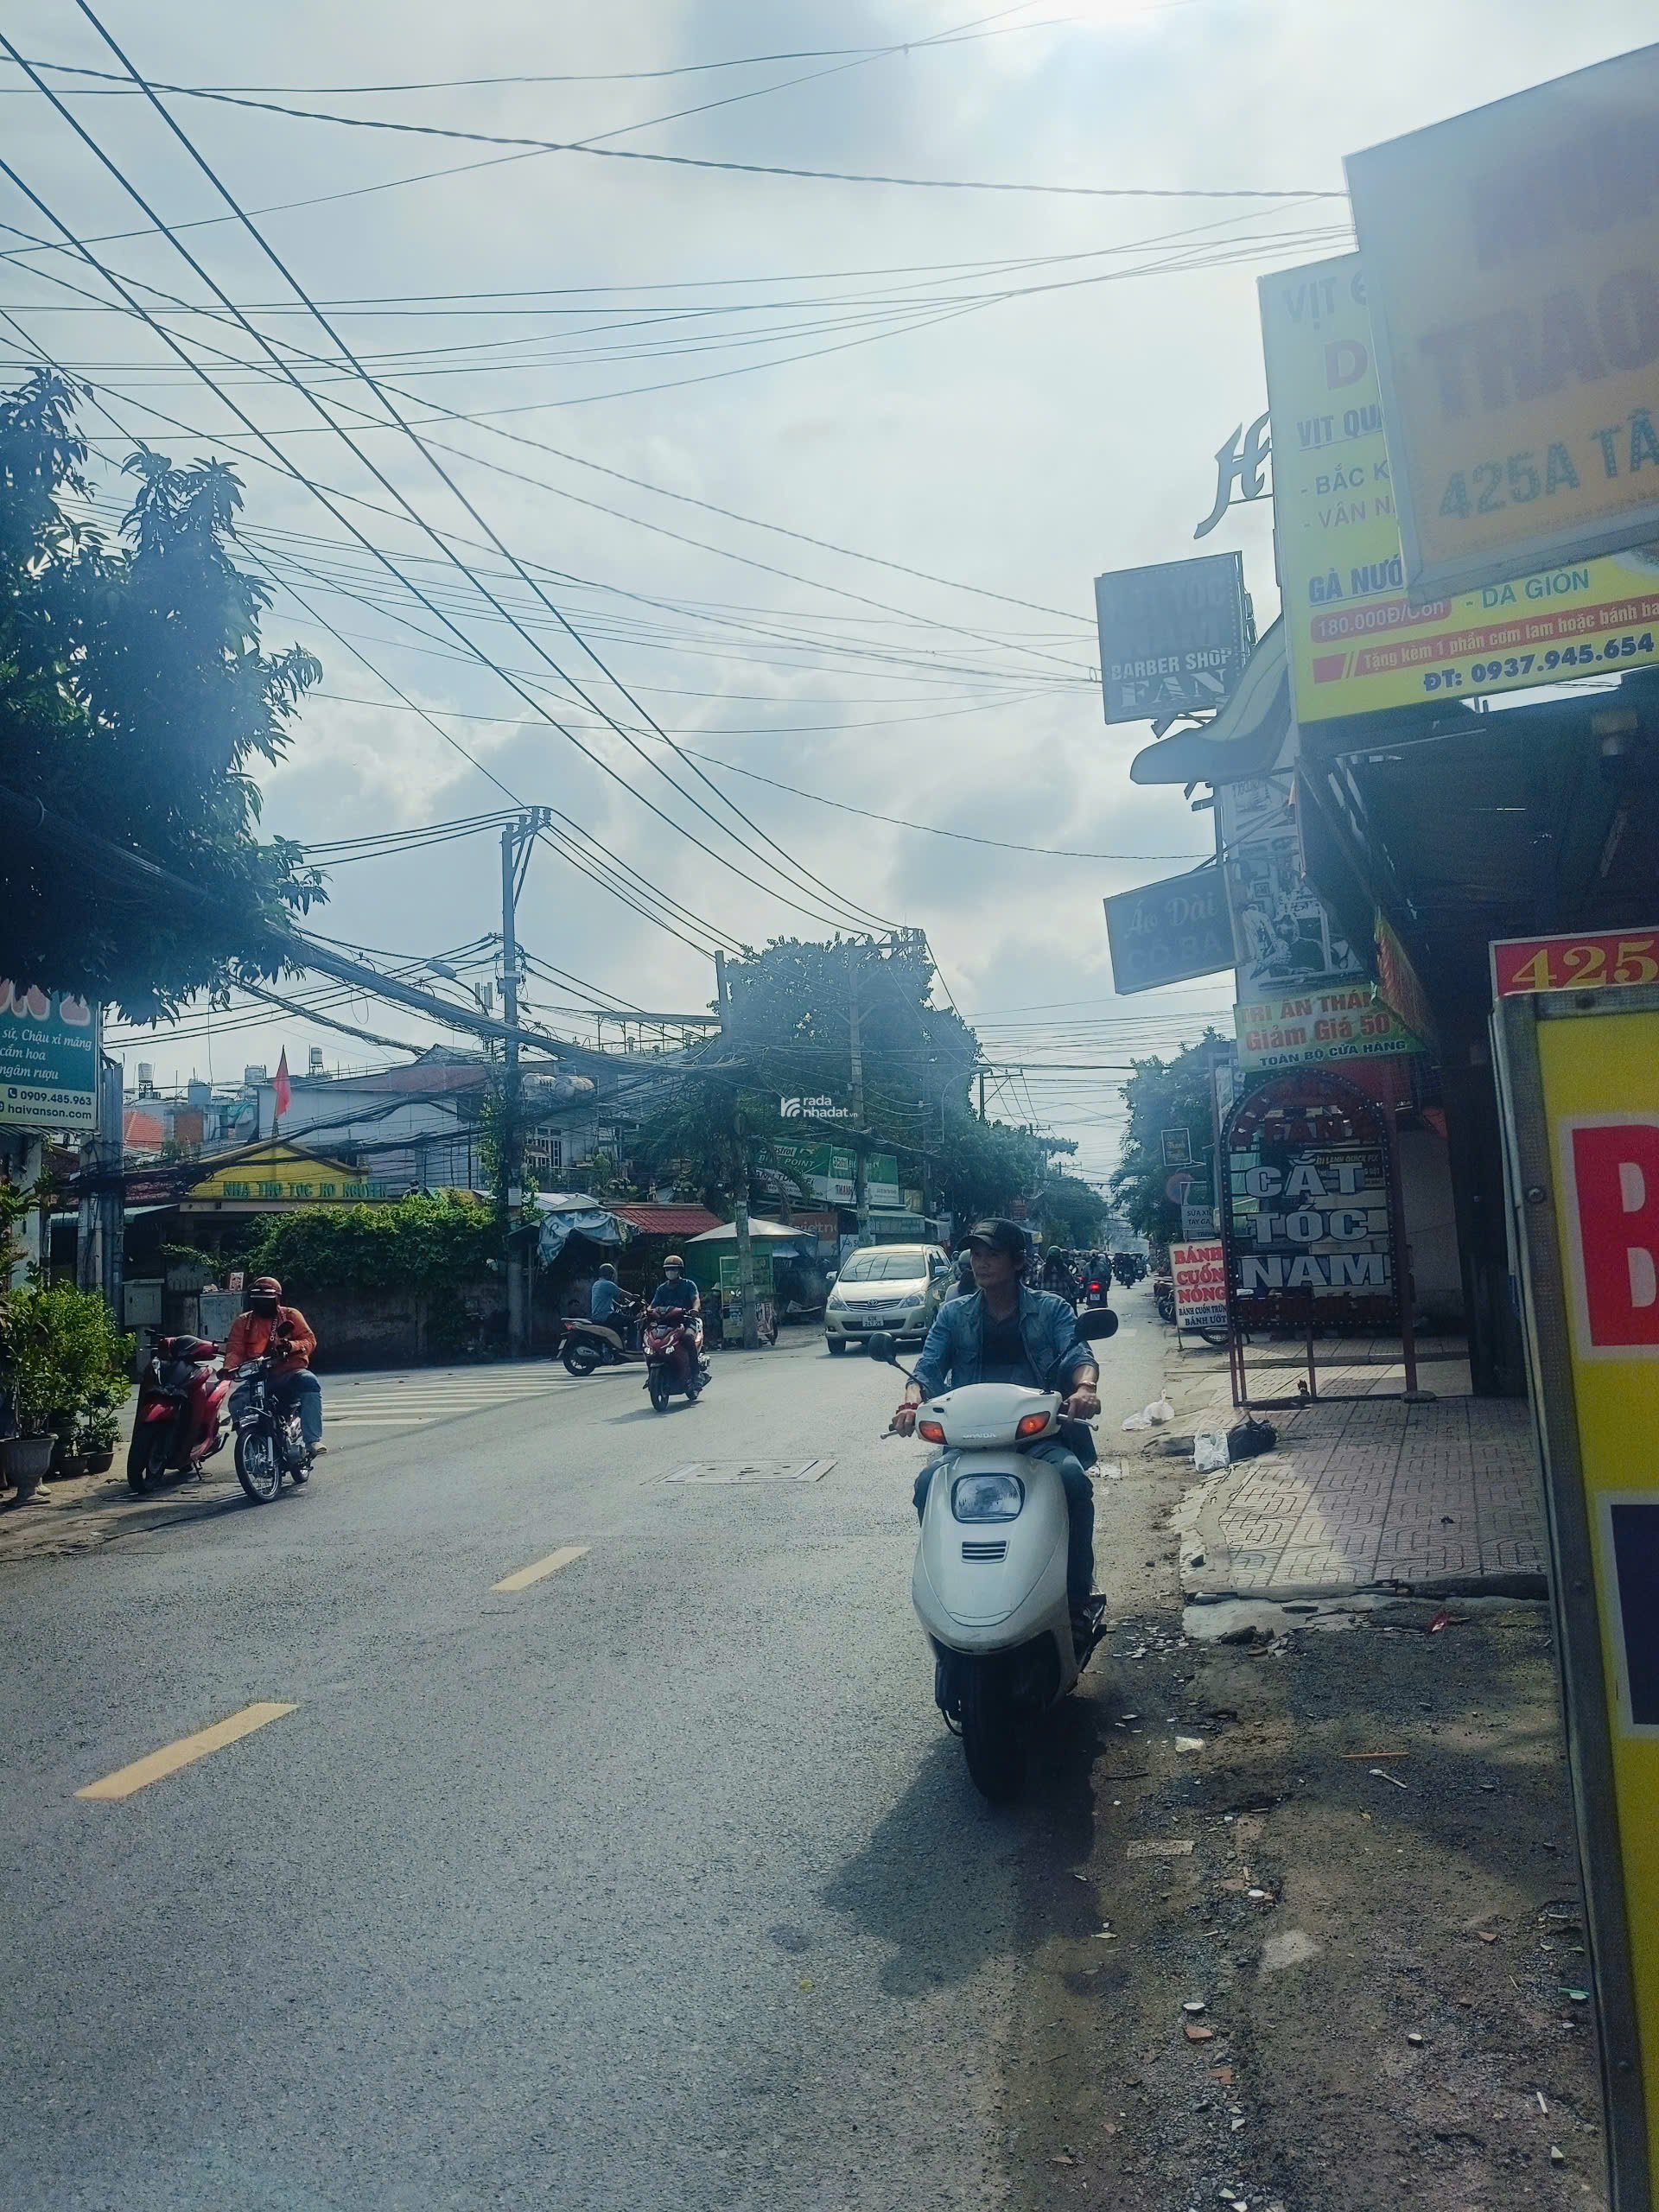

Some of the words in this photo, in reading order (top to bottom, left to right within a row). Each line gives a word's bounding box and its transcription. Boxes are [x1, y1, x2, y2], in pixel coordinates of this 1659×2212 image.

[1284, 276, 1338, 329] VỊT
[1297, 415, 1334, 450] VỊT
[1314, 462, 1363, 496] BẮC
[1439, 442, 1580, 519] 425A
[1318, 501, 1366, 530] VÂN
[1309, 567, 1343, 603] GÀ
[1524, 568, 1590, 601] GIÒN
[1363, 651, 1398, 671] Tặng
[1400, 645, 1433, 664] kèm
[1449, 632, 1485, 658] phần
[1489, 626, 1522, 647] cơm
[1525, 620, 1553, 639] lam
[1557, 613, 1595, 633] hoặc
[1599, 603, 1637, 625] bánh
[1110, 656, 1180, 681] BARBER
[1185, 648, 1232, 671] SHOP
[1423, 668, 1464, 693] ĐT:
[1470, 632, 1655, 683] 0937.945.654
[1120, 668, 1230, 708] FAN
[1123, 899, 1159, 940] Áo
[1163, 892, 1218, 927] Dài
[1511, 939, 1659, 992] 425
[1238, 1005, 1272, 1024] TRI
[1281, 998, 1313, 1020] ÂN
[3, 1027, 18, 1041] sứ,
[22, 1028, 49, 1045] Chậu
[52, 1033, 62, 1045] xi
[63, 1035, 92, 1051] măng
[1245, 1025, 1307, 1052] Giảm
[1313, 1016, 1353, 1042] Giá
[0, 1044, 23, 1058] cắm
[26, 1048, 46, 1061] hoa
[1259, 1052, 1300, 1067] TOÀN
[1304, 1047, 1324, 1062] BỘ
[1328, 1042, 1359, 1058] CỬA
[1363, 1039, 1407, 1053] HÀNG
[33, 1069, 59, 1082] rượu
[8, 1104, 92, 1120] haivanson.com
[20, 1090, 92, 1106] 0909.485.963
[785, 1159, 815, 1167] POINT
[1245, 1152, 1363, 1198] CẮT
[1247, 1203, 1370, 1244] TÓC
[1173, 1245, 1224, 1265] BÁNH
[1241, 1253, 1387, 1289] NAM
[1177, 1262, 1225, 1285] CUỐN
[1178, 1284, 1227, 1304] NÓNG
[1179, 1306, 1195, 1316] BÁNH
[1195, 1303, 1211, 1315] CUỐN
[1185, 1316, 1208, 1326] BÁNH
